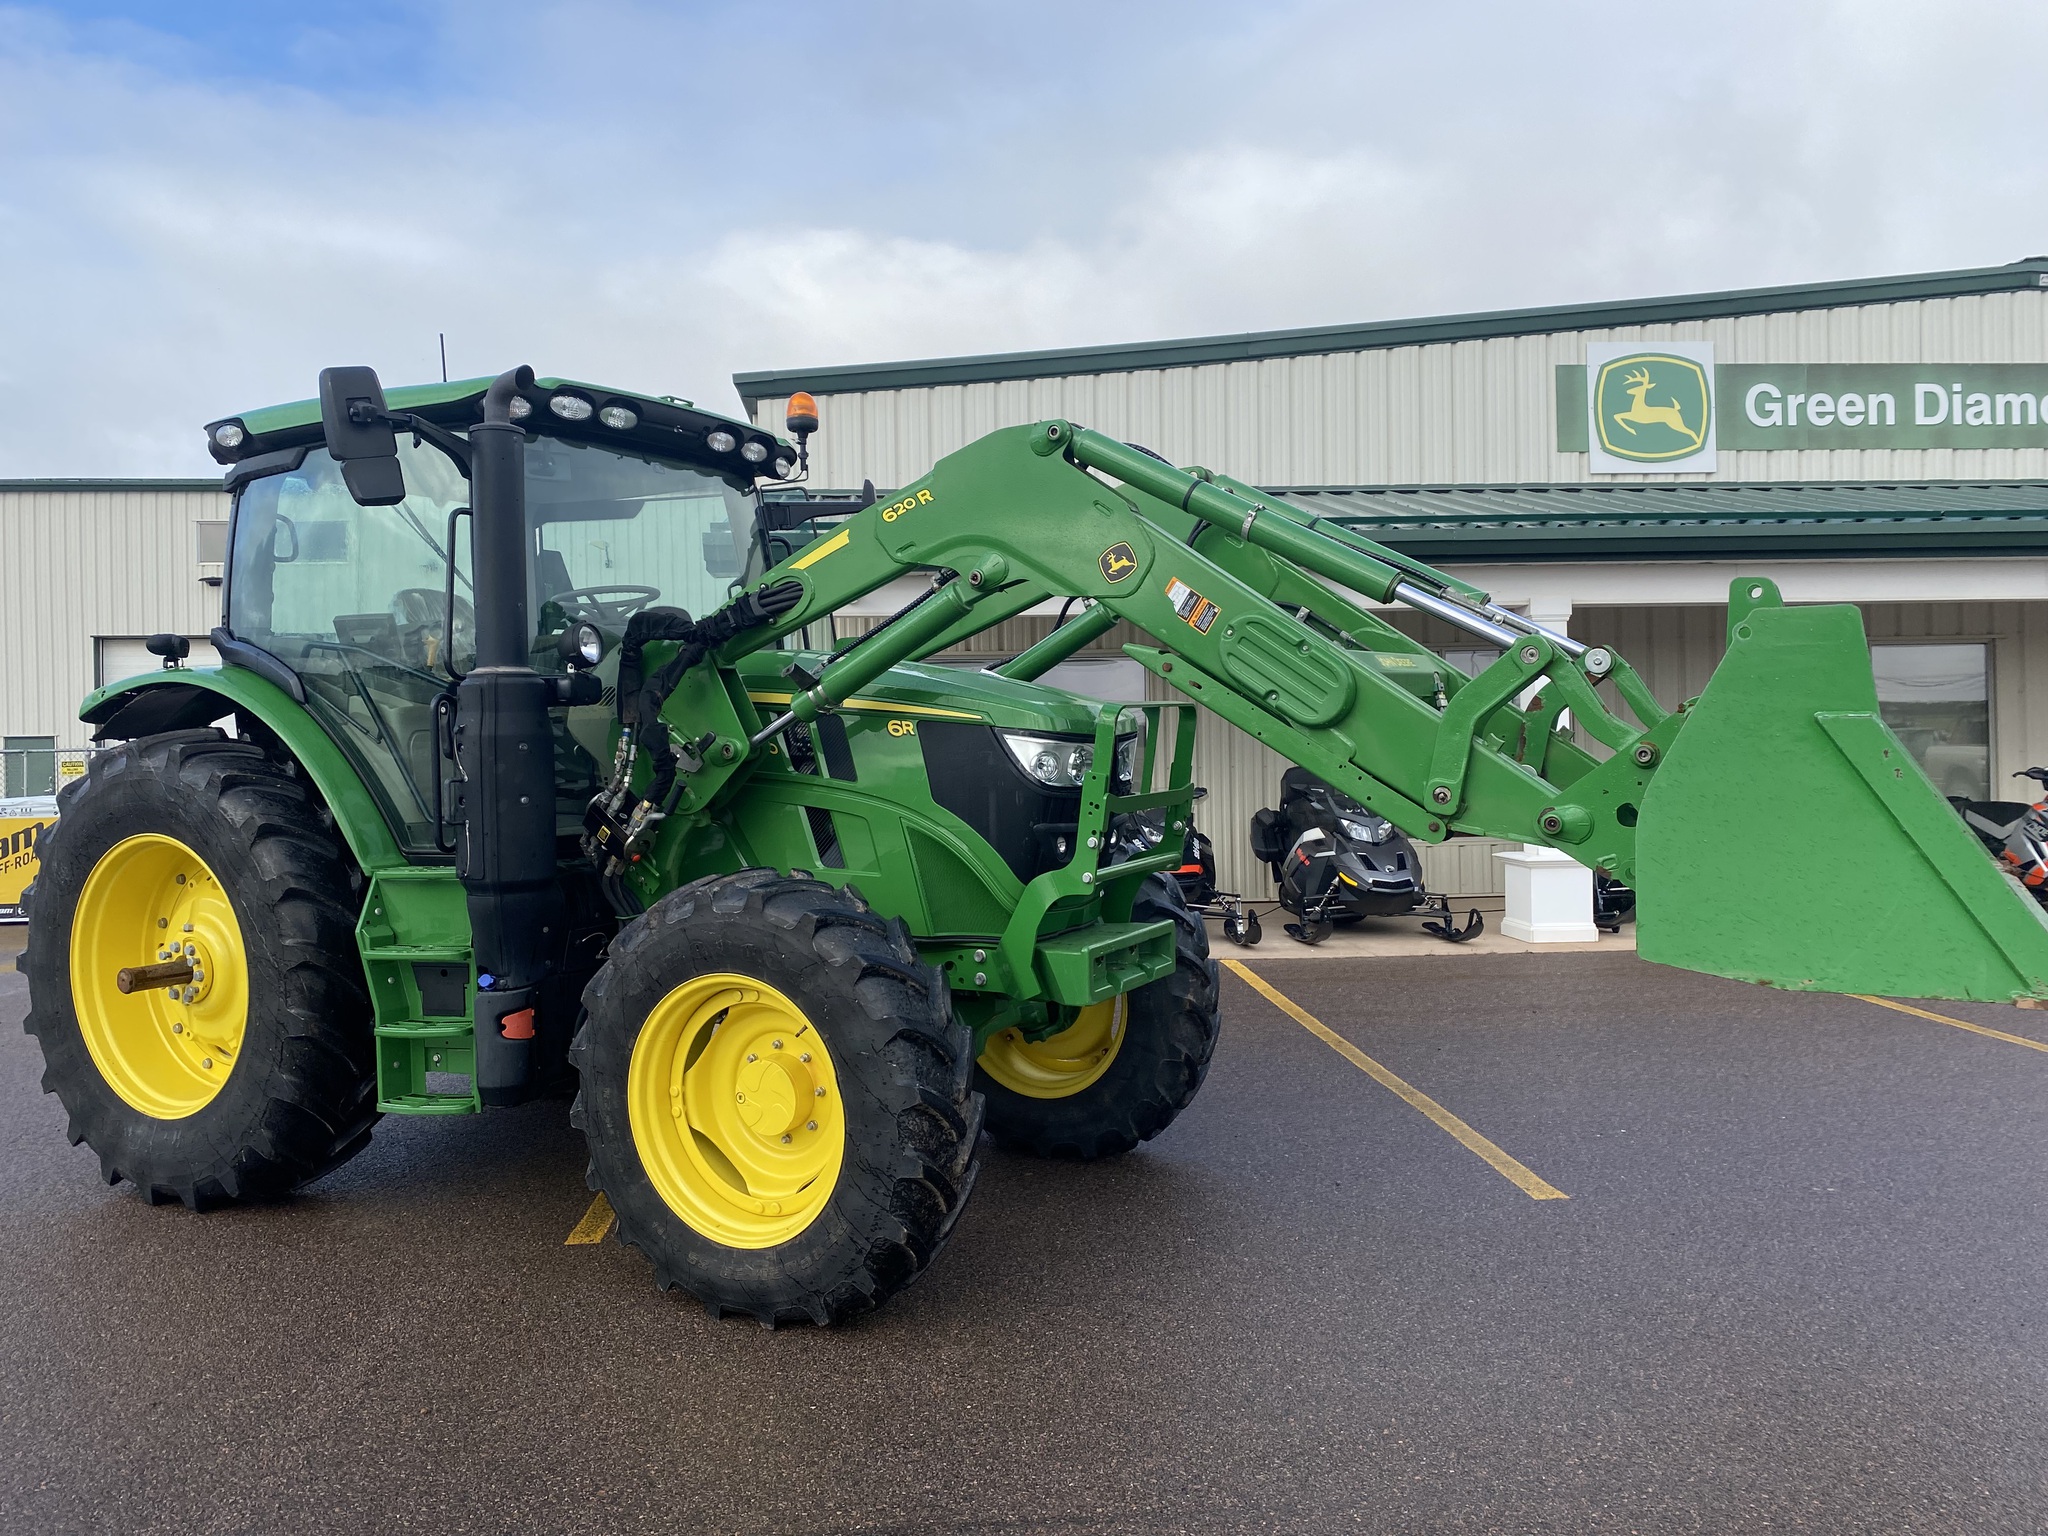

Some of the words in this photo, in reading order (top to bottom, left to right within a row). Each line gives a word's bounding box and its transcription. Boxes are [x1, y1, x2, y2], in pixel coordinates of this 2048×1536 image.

[1745, 382, 1896, 427] Green
[1914, 383, 2048, 425] Diam
[882, 497, 917, 523] 620
[915, 488, 935, 506] R
[887, 719, 916, 738] 6R
